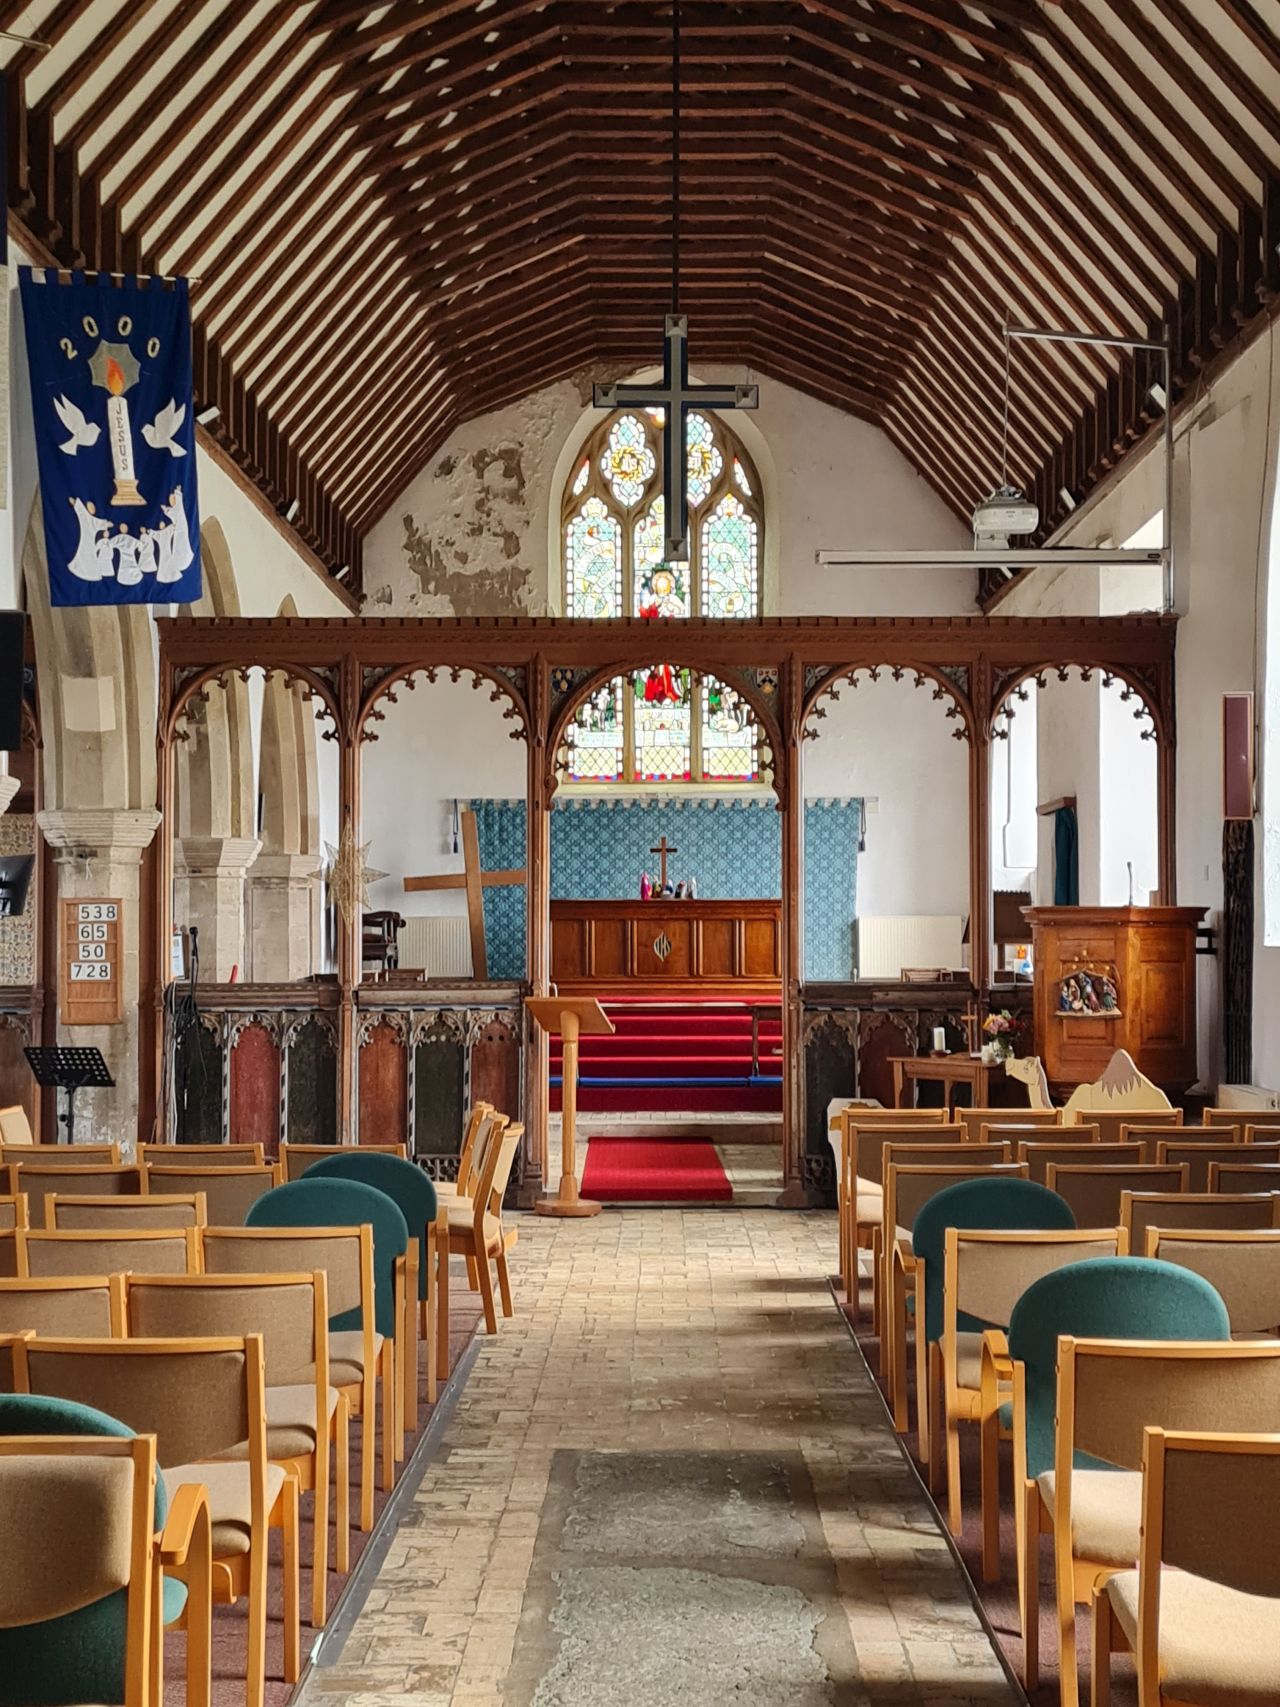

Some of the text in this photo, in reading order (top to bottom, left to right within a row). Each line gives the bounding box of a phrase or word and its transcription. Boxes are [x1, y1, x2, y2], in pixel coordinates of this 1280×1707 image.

[60, 315, 160, 359] 2000
[116, 403, 128, 471] JESUS
[81, 905, 116, 919] 538
[81, 925, 105, 939] 65
[82, 945, 104, 958] 50
[73, 964, 109, 978] 728
